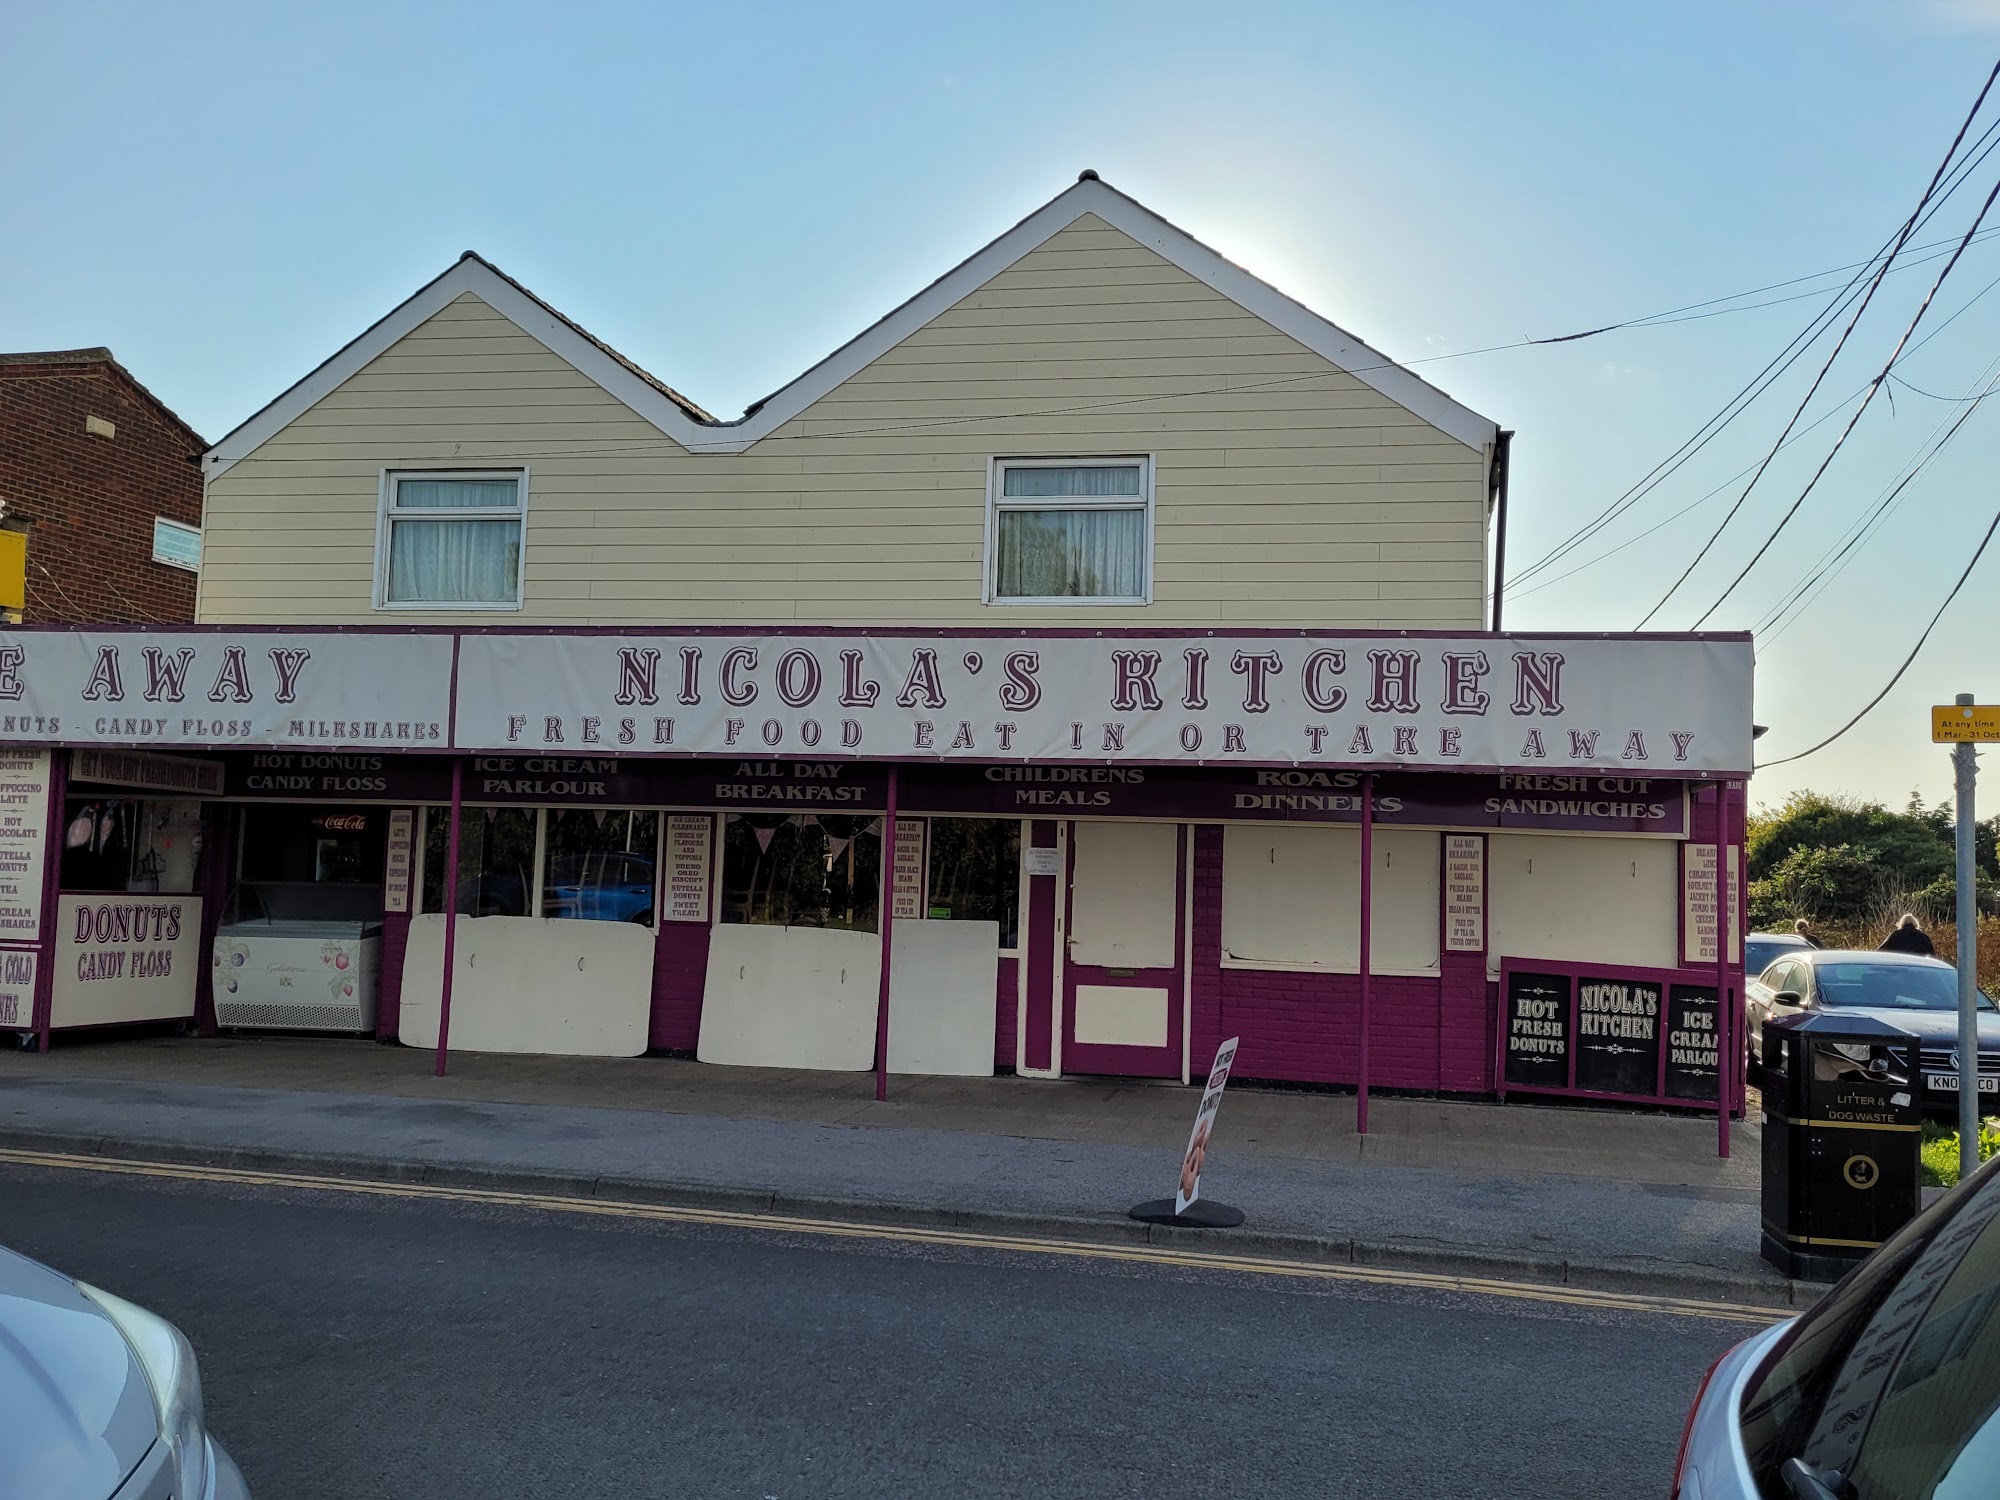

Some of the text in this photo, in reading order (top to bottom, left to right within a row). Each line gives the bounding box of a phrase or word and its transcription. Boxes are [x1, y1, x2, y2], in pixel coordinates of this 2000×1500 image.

[82, 645, 311, 703] AWAY
[614, 646, 1566, 716] NICOLA'S KITCHEN
[95, 717, 168, 736] CANDY
[181, 718, 252, 737] FLOSS
[287, 720, 440, 740] MILKSHAKES
[1941, 720, 1995, 729] At any time
[507, 714, 1695, 762] FRESH FOOD EAT IN OR TAKE AWAY
[1944, 731, 1962, 739] Mar
[1969, 731, 1980, 739] 31
[1983, 731, 2000, 739] Oct
[12, 749, 41, 759] FRESH
[252, 754, 383, 770] HOT DONUTS
[474, 757, 619, 774] ICE CREAM
[734, 761, 844, 778] ALL DAY
[246, 775, 388, 791] CANDY FLOSS
[984, 767, 1145, 784] CHILDRENS
[1255, 771, 1381, 788] ROAST
[482, 779, 607, 796] PARLOUR
[714, 783, 867, 801] BREAKFAST
[1499, 775, 1652, 794] FRESH CUT
[0, 795, 29, 804] LATTE
[1014, 789, 1112, 806] MEALS
[1484, 797, 1666, 819] SANDWICHES
[4, 817, 22, 827] HOT
[671, 823, 709, 831] MILKSHAKES
[673, 839, 704, 847] FLAVOURS
[1453, 839, 1475, 849] ALL DAY
[1448, 850, 1480, 860] BREAKFAST
[0, 885, 18, 894] TEA
[673, 892, 701, 900] DONUTS
[1689, 892, 1710, 902] JACKET
[673, 901, 699, 909] SWEET
[1456, 894, 1473, 902] BEANS
[0, 908, 31, 917] CREAM
[672, 909, 700, 917] TREATS
[1691, 904, 1709, 913] JUMBO
[74, 903, 181, 943] DONUTS
[1466, 919, 1475, 927] CUP
[1453, 928, 1460, 937] OF
[1460, 928, 1469, 937] TEA
[1699, 947, 1708, 957] ICE
[5, 953, 33, 985] COLD
[77, 949, 172, 981] CANDY FLOSS
[1580, 984, 1658, 1015] NICOLA'S
[1516, 998, 1559, 1019] HOT
[1512, 1018, 1563, 1037] FRESH
[1581, 1012, 1654, 1040] KITCHEN
[1682, 1010, 1714, 1030] ICE
[1509, 1036, 1565, 1055] DONUTS
[1671, 1048, 1718, 1066] PARLOU
[1837, 1094, 1876, 1106] LITTER
[1877, 1097, 1886, 1108] &
[1828, 1110, 1895, 1123] DOG WASTE
